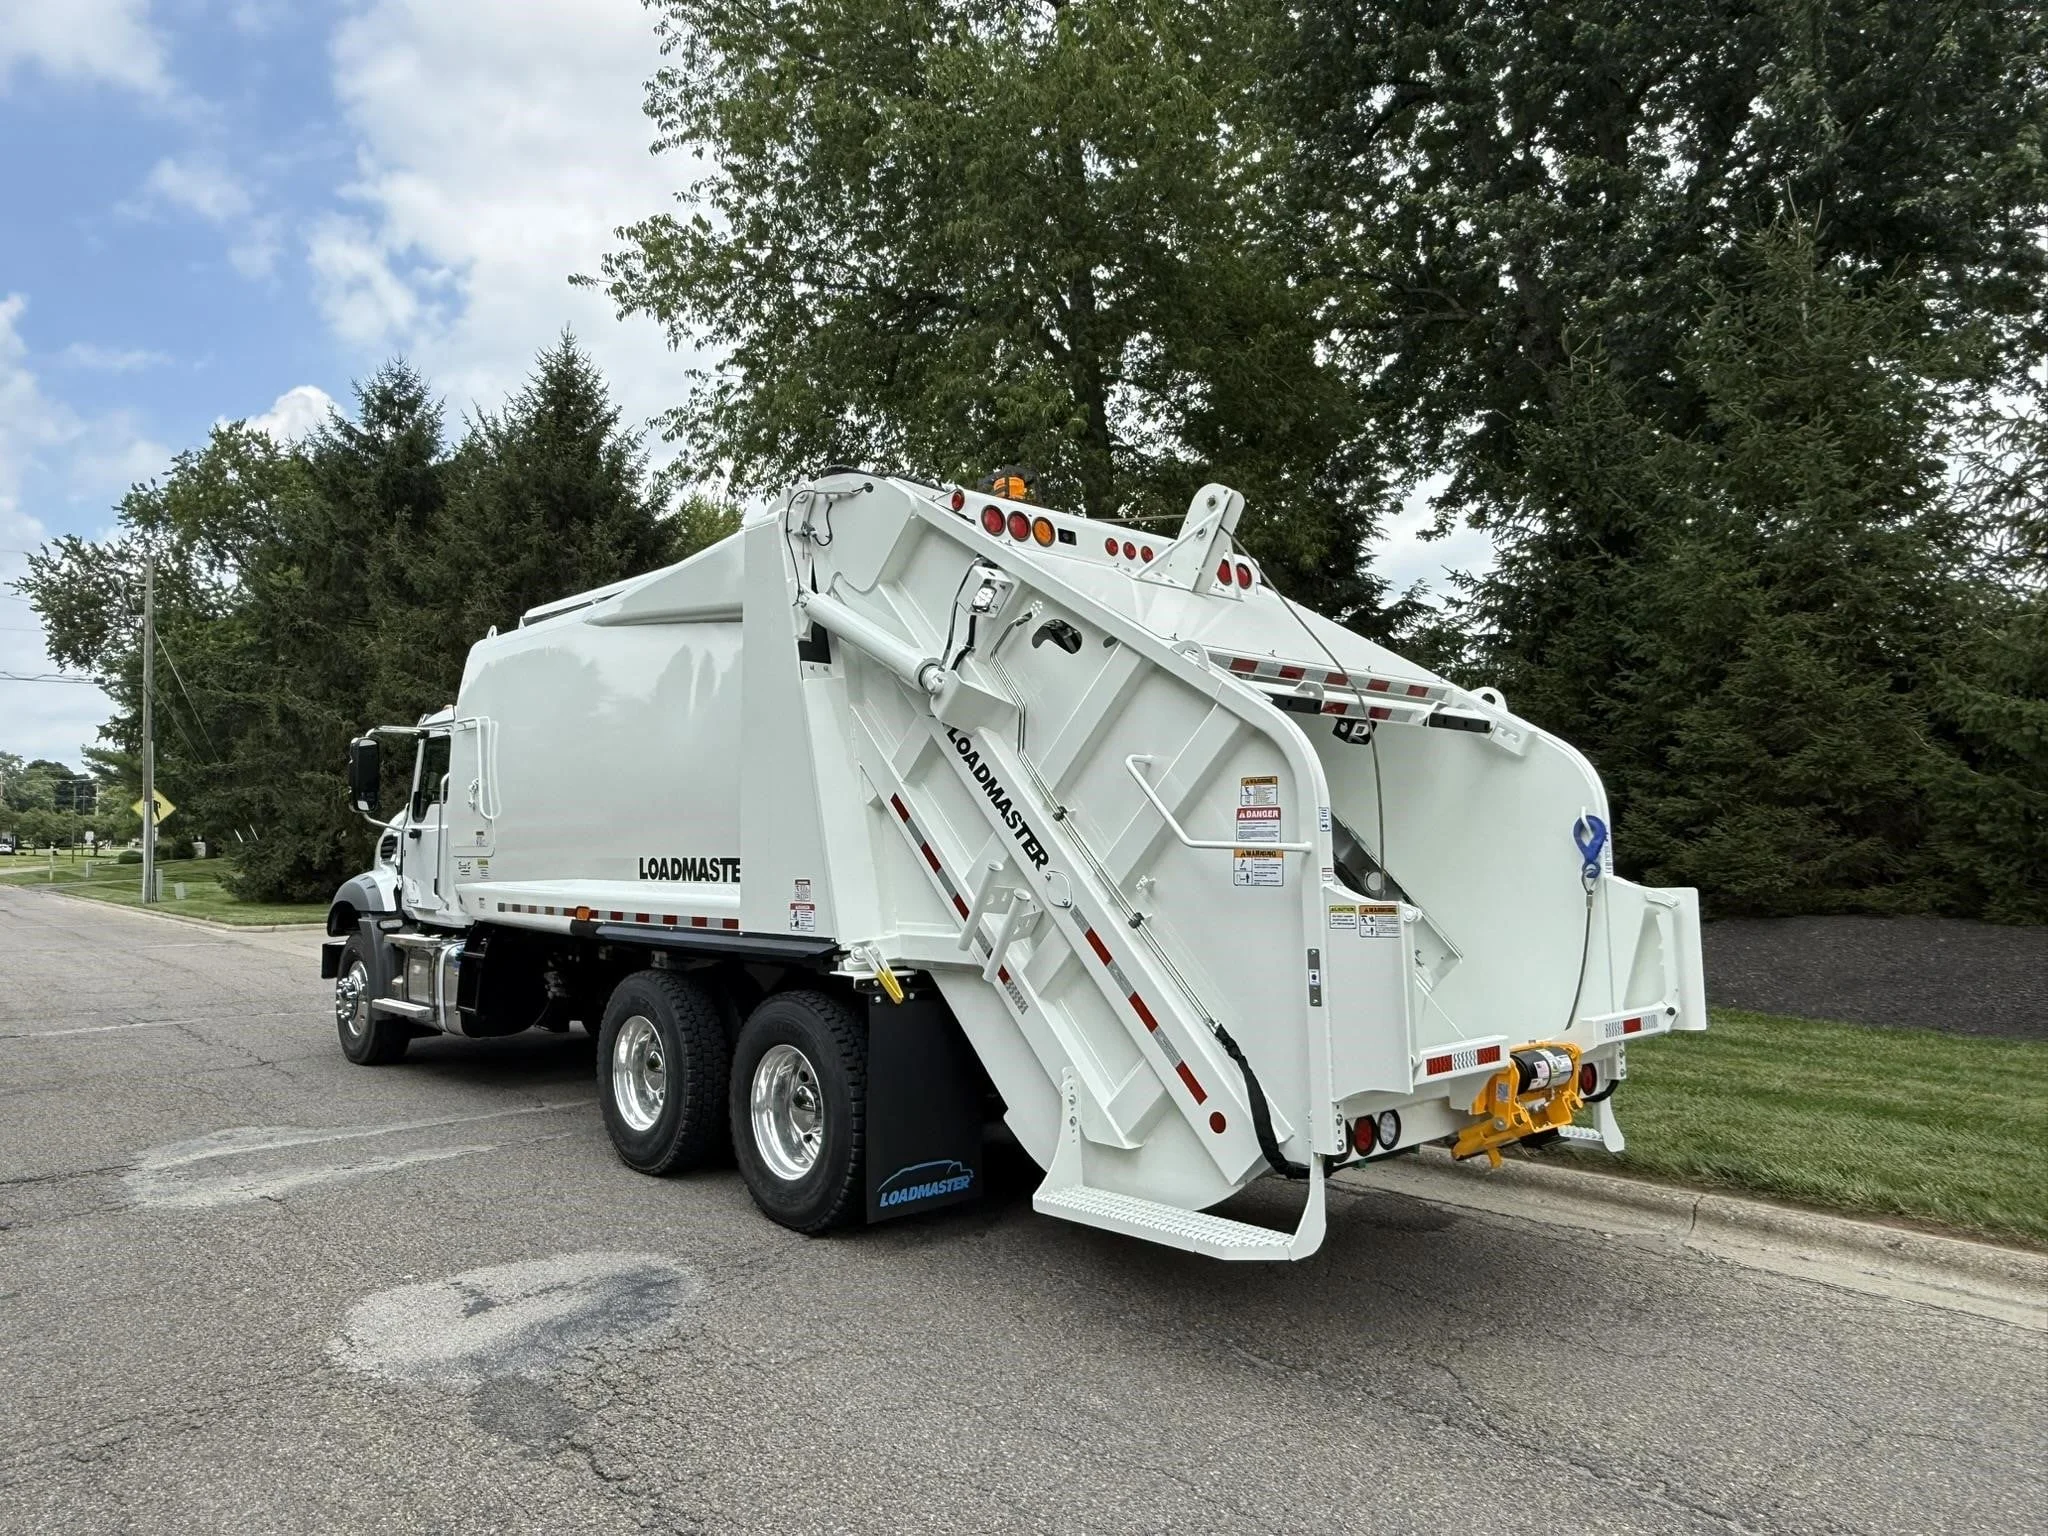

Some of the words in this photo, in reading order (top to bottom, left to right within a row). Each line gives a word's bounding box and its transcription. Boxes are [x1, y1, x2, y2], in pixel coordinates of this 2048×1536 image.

[946, 727, 1050, 872] LOADMASTER
[1246, 810, 1279, 819] DANGER
[880, 1175, 970, 1208] LOADMASTER
